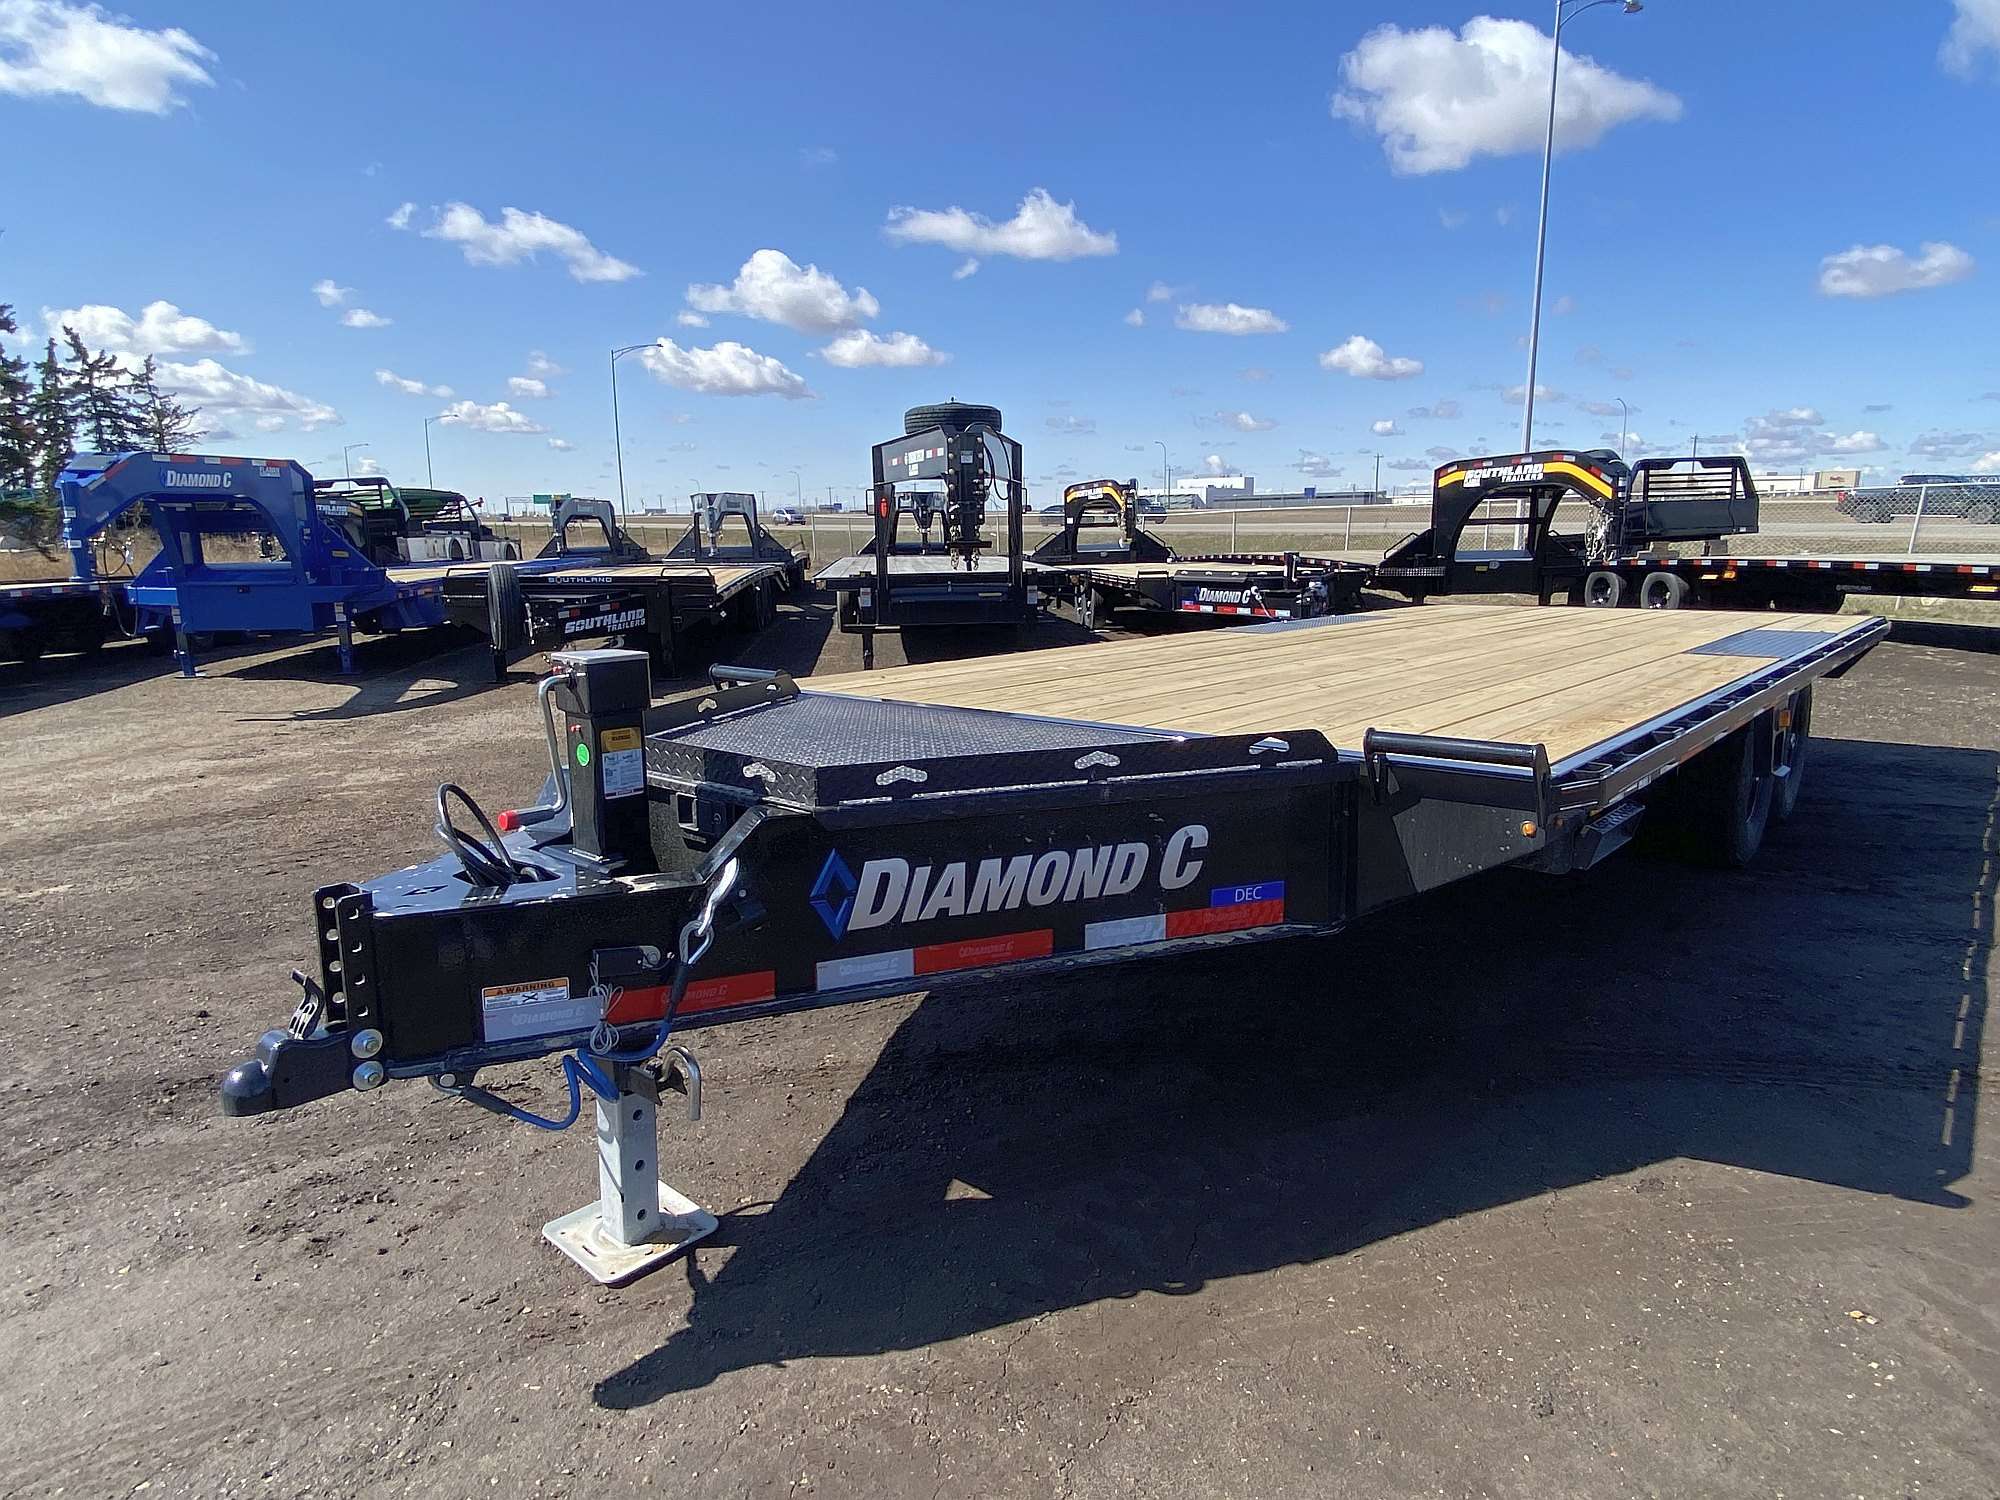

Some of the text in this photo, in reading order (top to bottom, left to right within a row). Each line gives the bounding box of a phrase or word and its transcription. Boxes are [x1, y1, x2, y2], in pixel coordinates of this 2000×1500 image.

[167, 469, 232, 488] DIAMOND C
[1465, 463, 1543, 479] SOUTHLAND
[548, 576, 613, 584] SOUTHLAND
[1199, 587, 1251, 604] DIAMOND C
[564, 608, 645, 634] SOUTHLAND
[607, 618, 646, 633] TRAILERS
[847, 824, 1210, 931] DIAMOND C
[1234, 886, 1263, 903] DEC
[505, 981, 555, 993] WARNING
